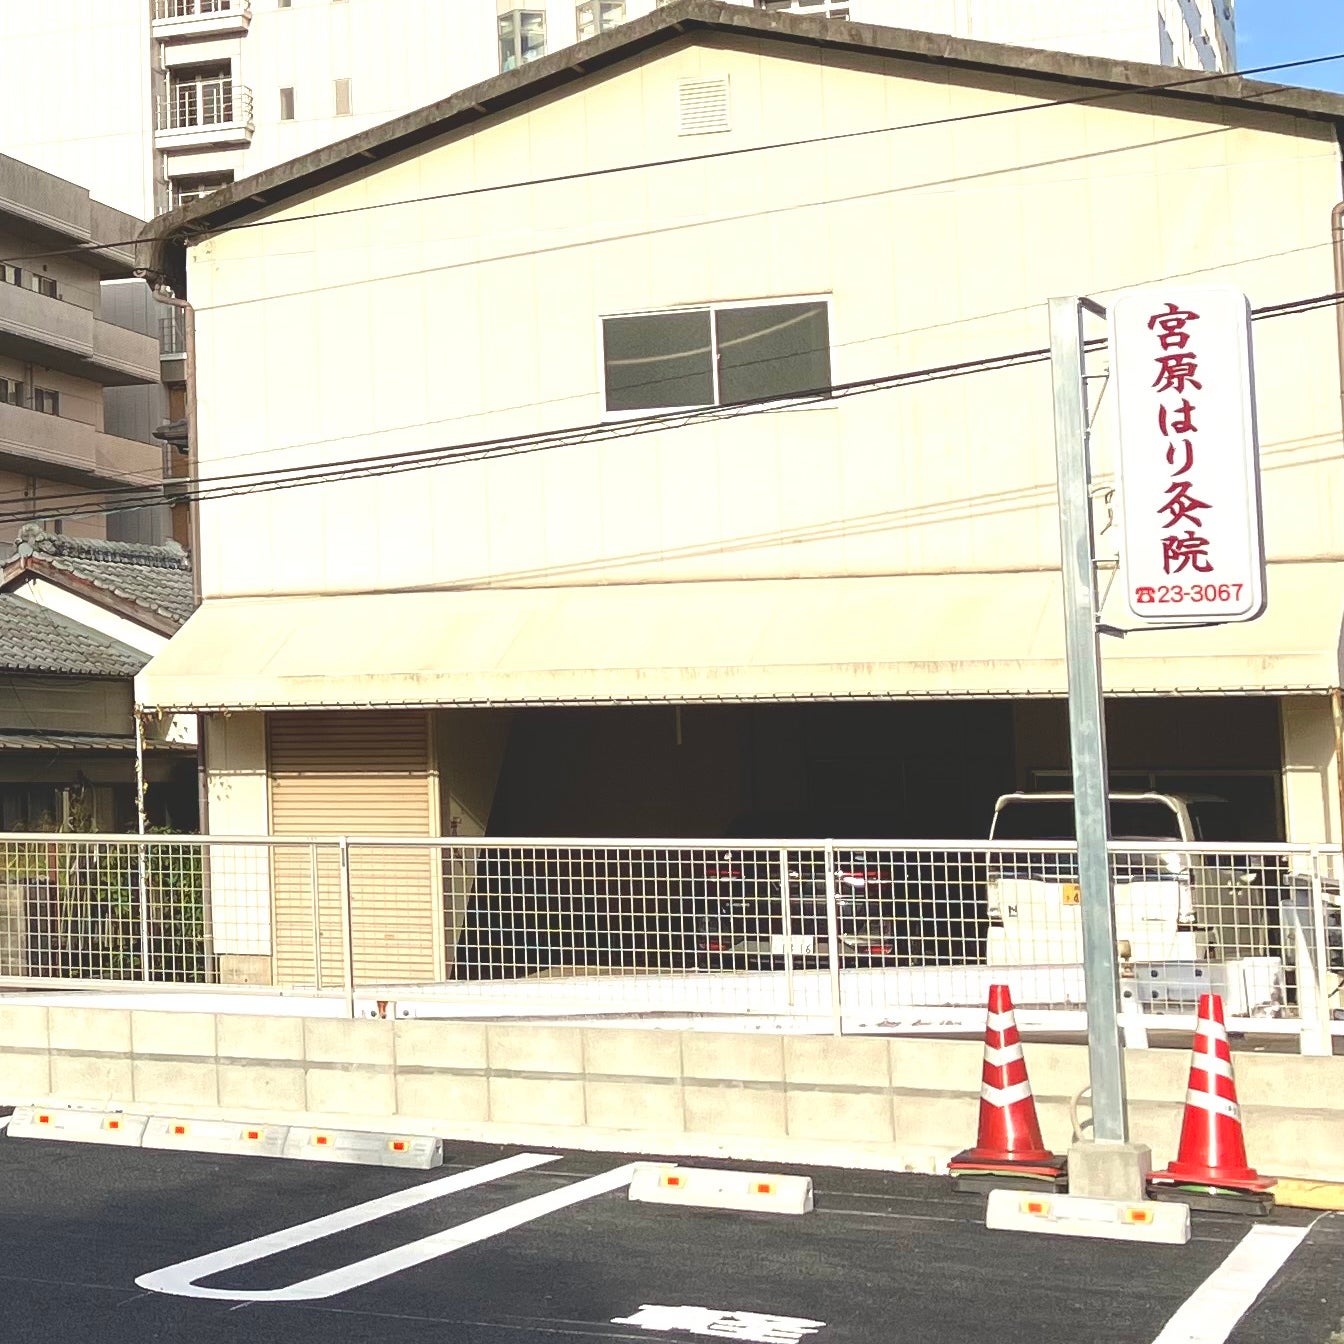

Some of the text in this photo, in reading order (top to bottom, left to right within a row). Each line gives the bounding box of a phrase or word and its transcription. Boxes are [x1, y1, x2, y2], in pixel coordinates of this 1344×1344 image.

[1146, 302, 1215, 576] 宮原はり灸院
[1157, 583, 1244, 603] 23-3067
